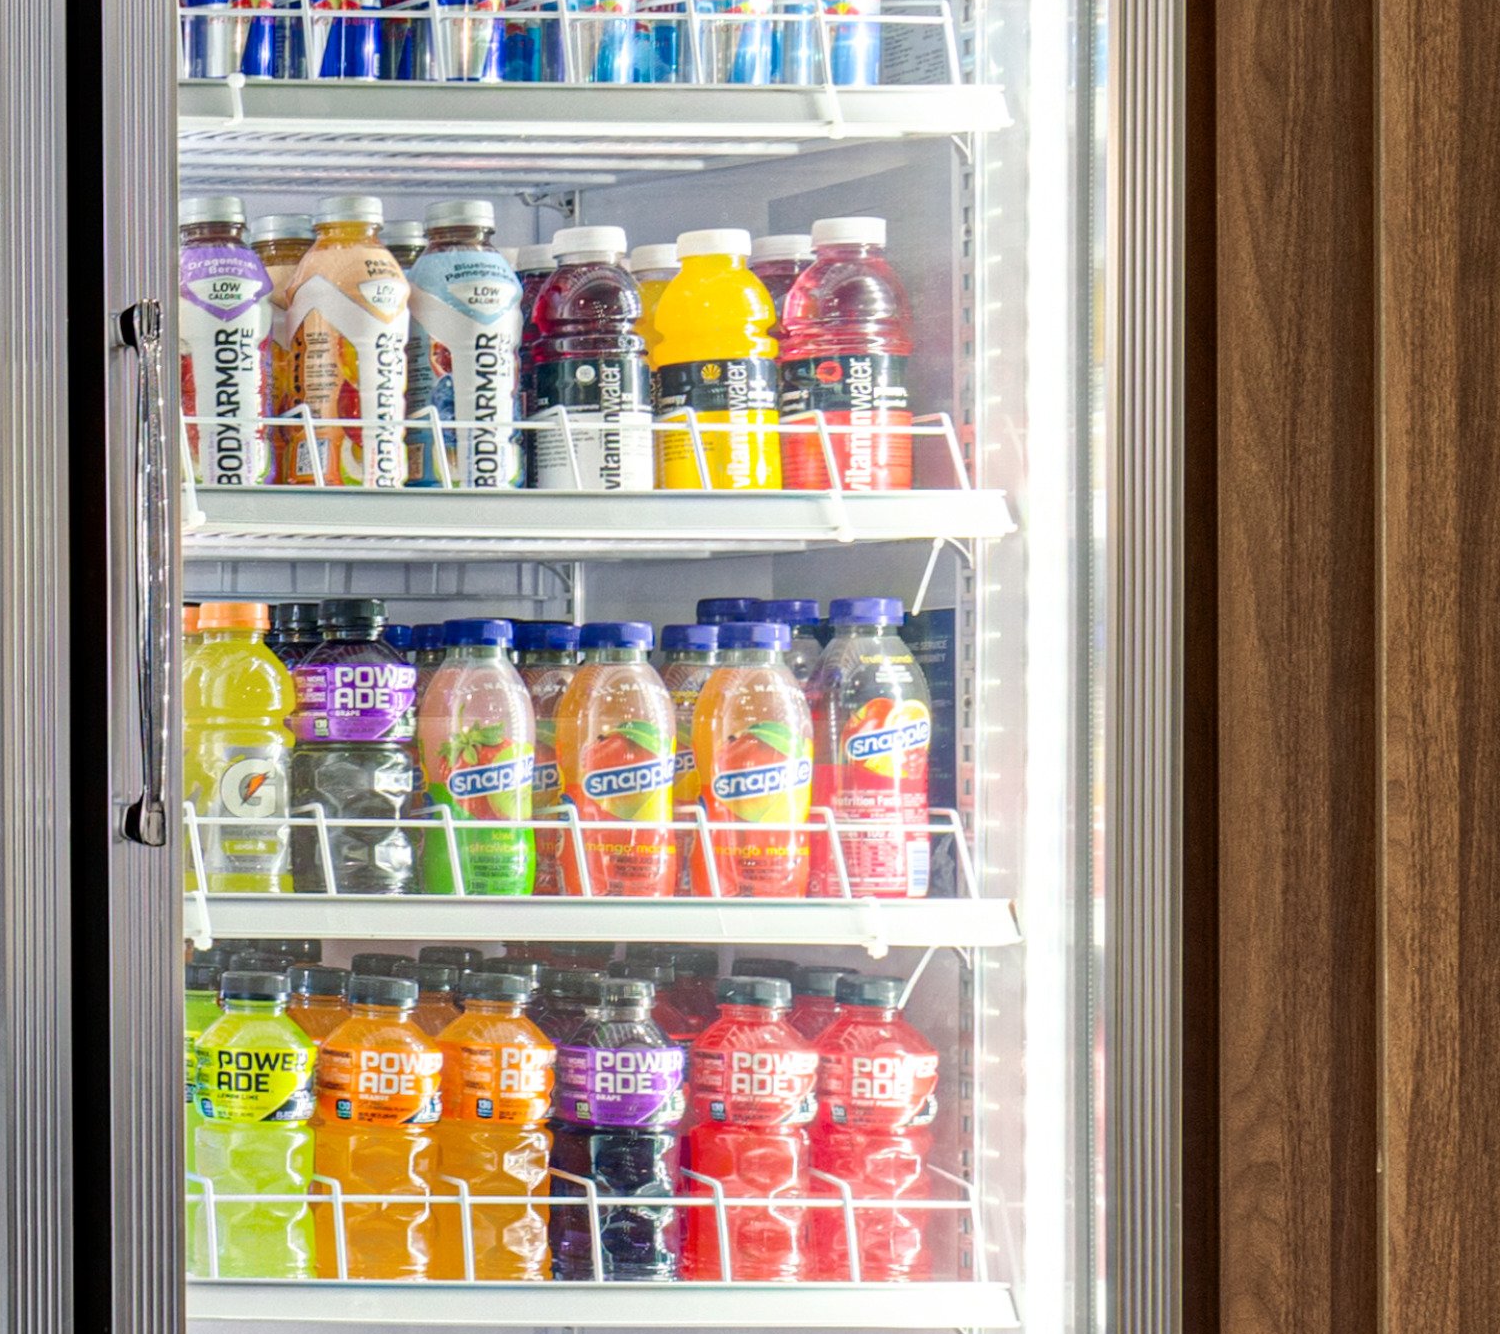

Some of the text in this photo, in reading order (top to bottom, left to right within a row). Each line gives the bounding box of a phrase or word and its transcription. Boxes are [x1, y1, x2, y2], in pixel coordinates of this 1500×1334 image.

[208, 292, 242, 301] CALORIE
[213, 282, 241, 293] LOW
[240, 327, 254, 371] LYTE
[215, 328, 242, 486] BODYARMOR
[335, 666, 416, 688] POWER
[335, 688, 391, 709] ADE
[587, 842, 632, 855] mango
[218, 1050, 306, 1072] POWER
[596, 1050, 682, 1072] POWER
[217, 1071, 269, 1092] ADE
[595, 1073, 652, 1094] ADE
